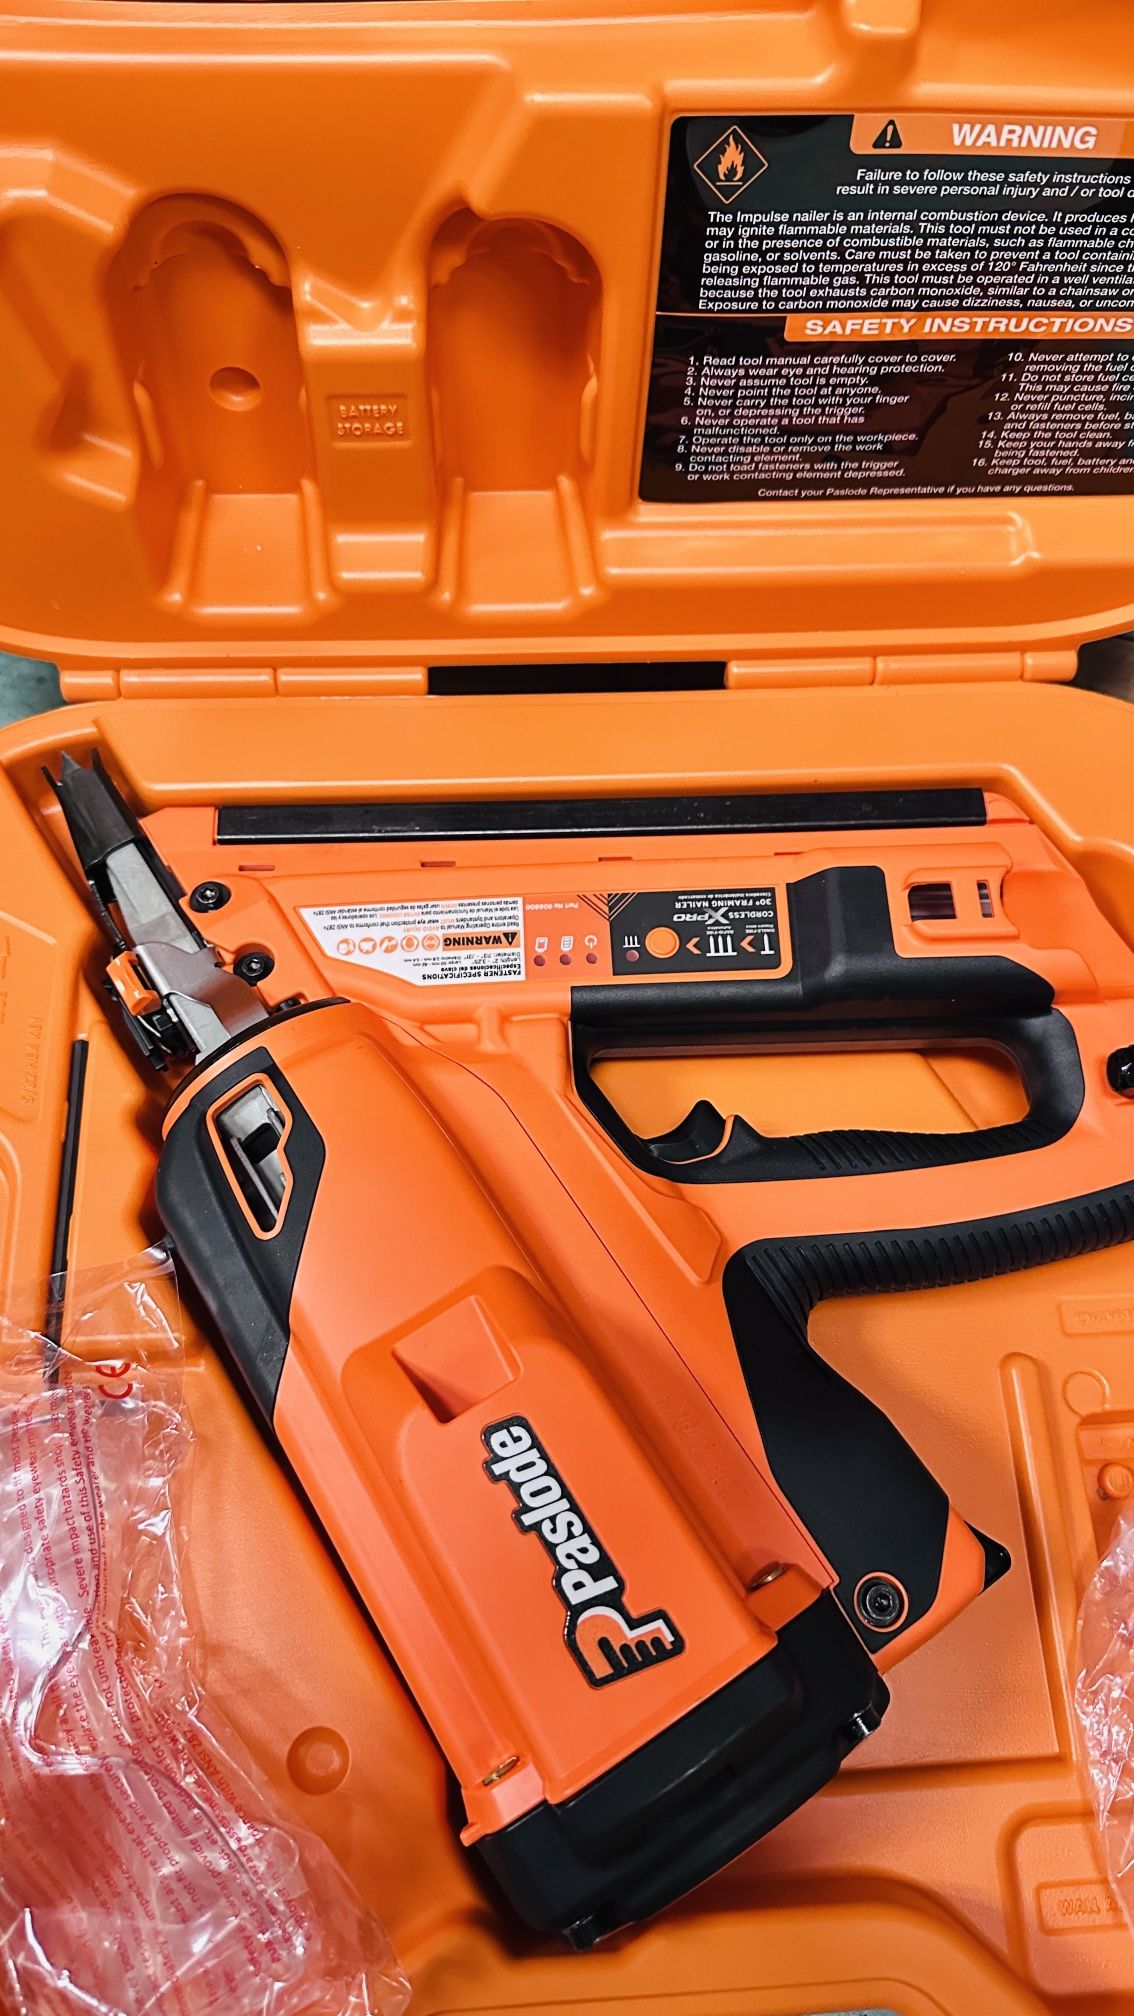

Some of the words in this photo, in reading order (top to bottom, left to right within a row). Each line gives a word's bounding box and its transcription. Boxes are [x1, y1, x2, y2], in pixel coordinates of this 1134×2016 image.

[952, 123, 1097, 149] WARNING
[856, 169, 902, 181] Failure
[905, 169, 919, 180] to
[923, 169, 964, 181] follow
[967, 169, 1004, 182] these
[1008, 170, 1050, 185] safety
[1053, 171, 1131, 184] instructions
[836, 183, 874, 195] result
[876, 184, 889, 195] in
[892, 186, 937, 195] severe
[940, 184, 999, 199] personal
[1002, 185, 1039, 200] injury
[1042, 185, 1068, 197] and
[1070, 186, 1078, 197] /
[1080, 188, 1095, 197] or
[1098, 186, 1124, 198] tool
[706, 211, 733, 223] The
[736, 211, 789, 226] Impulse
[792, 210, 829, 222] nailer
[832, 210, 844, 222] is
[847, 213, 863, 222] an
[867, 210, 916, 222] internal
[920, 210, 998, 222] combustion
[1002, 210, 1049, 222] device.
[1053, 211, 1062, 222] It
[1065, 211, 1127, 226] produces
[706, 227, 734, 239] may
[738, 224, 774, 239] ignite
[778, 223, 847, 235] flammable
[850, 222, 914, 235] materials.
[917, 222, 945, 234] This
[948, 222, 975, 234] tool
[978, 223, 1010, 235] must
[1014, 223, 1036, 235] not
[1038, 223, 1056, 235] be
[1059, 224, 1092, 236] used
[1094, 224, 1106, 236] in
[1110, 227, 1118, 236] a
[704, 240, 719, 249] or
[722, 237, 734, 249] in
[737, 237, 759, 249] the
[762, 239, 823, 252] presence
[826, 236, 840, 248] of
[843, 236, 923, 248] combustible
[927, 236, 990, 250] materials,
[994, 236, 1025, 247] such
[1028, 238, 1044, 248] as
[1047, 236, 1115, 249] flammable
[805, 318, 917, 335] SAFETY
[923, 317, 1134, 334] INSTRUCTIONS
[688, 356, 700, 366] 1.
[702, 355, 735, 366] Read
[738, 355, 762, 366] tool
[766, 354, 810, 366] manual
[813, 354, 864, 368] carefully
[868, 355, 902, 364] cover
[905, 353, 917, 364] to
[920, 355, 957, 363] cover.
[1006, 353, 1025, 362] 10.
[1028, 353, 1064, 362] Never
[1066, 352, 1114, 364] attempt
[1116, 352, 1129, 361] to
[687, 367, 698, 377] 2.
[701, 367, 745, 379] Always
[748, 368, 778, 376] wear
[781, 368, 803, 378] eye
[806, 365, 829, 375] and
[832, 365, 877, 378] hearing
[880, 364, 945, 377] protection.
[1024, 362, 1080, 374] removing
[1083, 362, 1102, 372] the
[1105, 362, 1128, 371] fuel
[685, 378, 697, 387] 3.
[700, 377, 736, 387] Never
[739, 378, 786, 386] assume
[790, 376, 812, 386] tool
[816, 376, 826, 385] is
[829, 376, 869, 388] empty.
[1000, 373, 1018, 382] 11.
[1021, 373, 1038, 382] Do
[1041, 373, 1061, 382] not
[1064, 372, 1094, 382] store
[1097, 372, 1120, 382] fuel
[684, 388, 696, 397] 4.
[699, 387, 734, 397] Never
[738, 387, 768, 399] point
[772, 386, 790, 396] the
[794, 386, 817, 396] tool
[820, 386, 831, 395] at
[835, 388, 882, 398] anyone.
[339, 404, 397, 418] BATTERY
[337, 422, 404, 436] STORAGE
[711, 899, 753, 907] FRAMING
[456, 916, 483, 924] bystanders
[673, 907, 730, 925] XPRO
[728, 910, 773, 919] CORDLESS
[444, 935, 502, 946] WARNING
[422, 971, 481, 980] SPECIFICATIONS
[483, 969, 521, 977] FASTENER
[71, 1449, 85, 1485] Safety
[58, 1471, 73, 1514] hazards
[78, 1487, 90, 1508] this
[33, 1496, 48, 1533] safety
[80, 1509, 92, 1522] of
[490, 1424, 619, 1607] Paslode
[17, 1503, 34, 1556] designed
[68, 1515, 83, 1556] impact
[87, 1525, 97, 1545] use
[90, 1548, 101, 1571] and
[74, 1557, 89, 1599] Severe
[199, 1749, 222, 1777] ANSI
